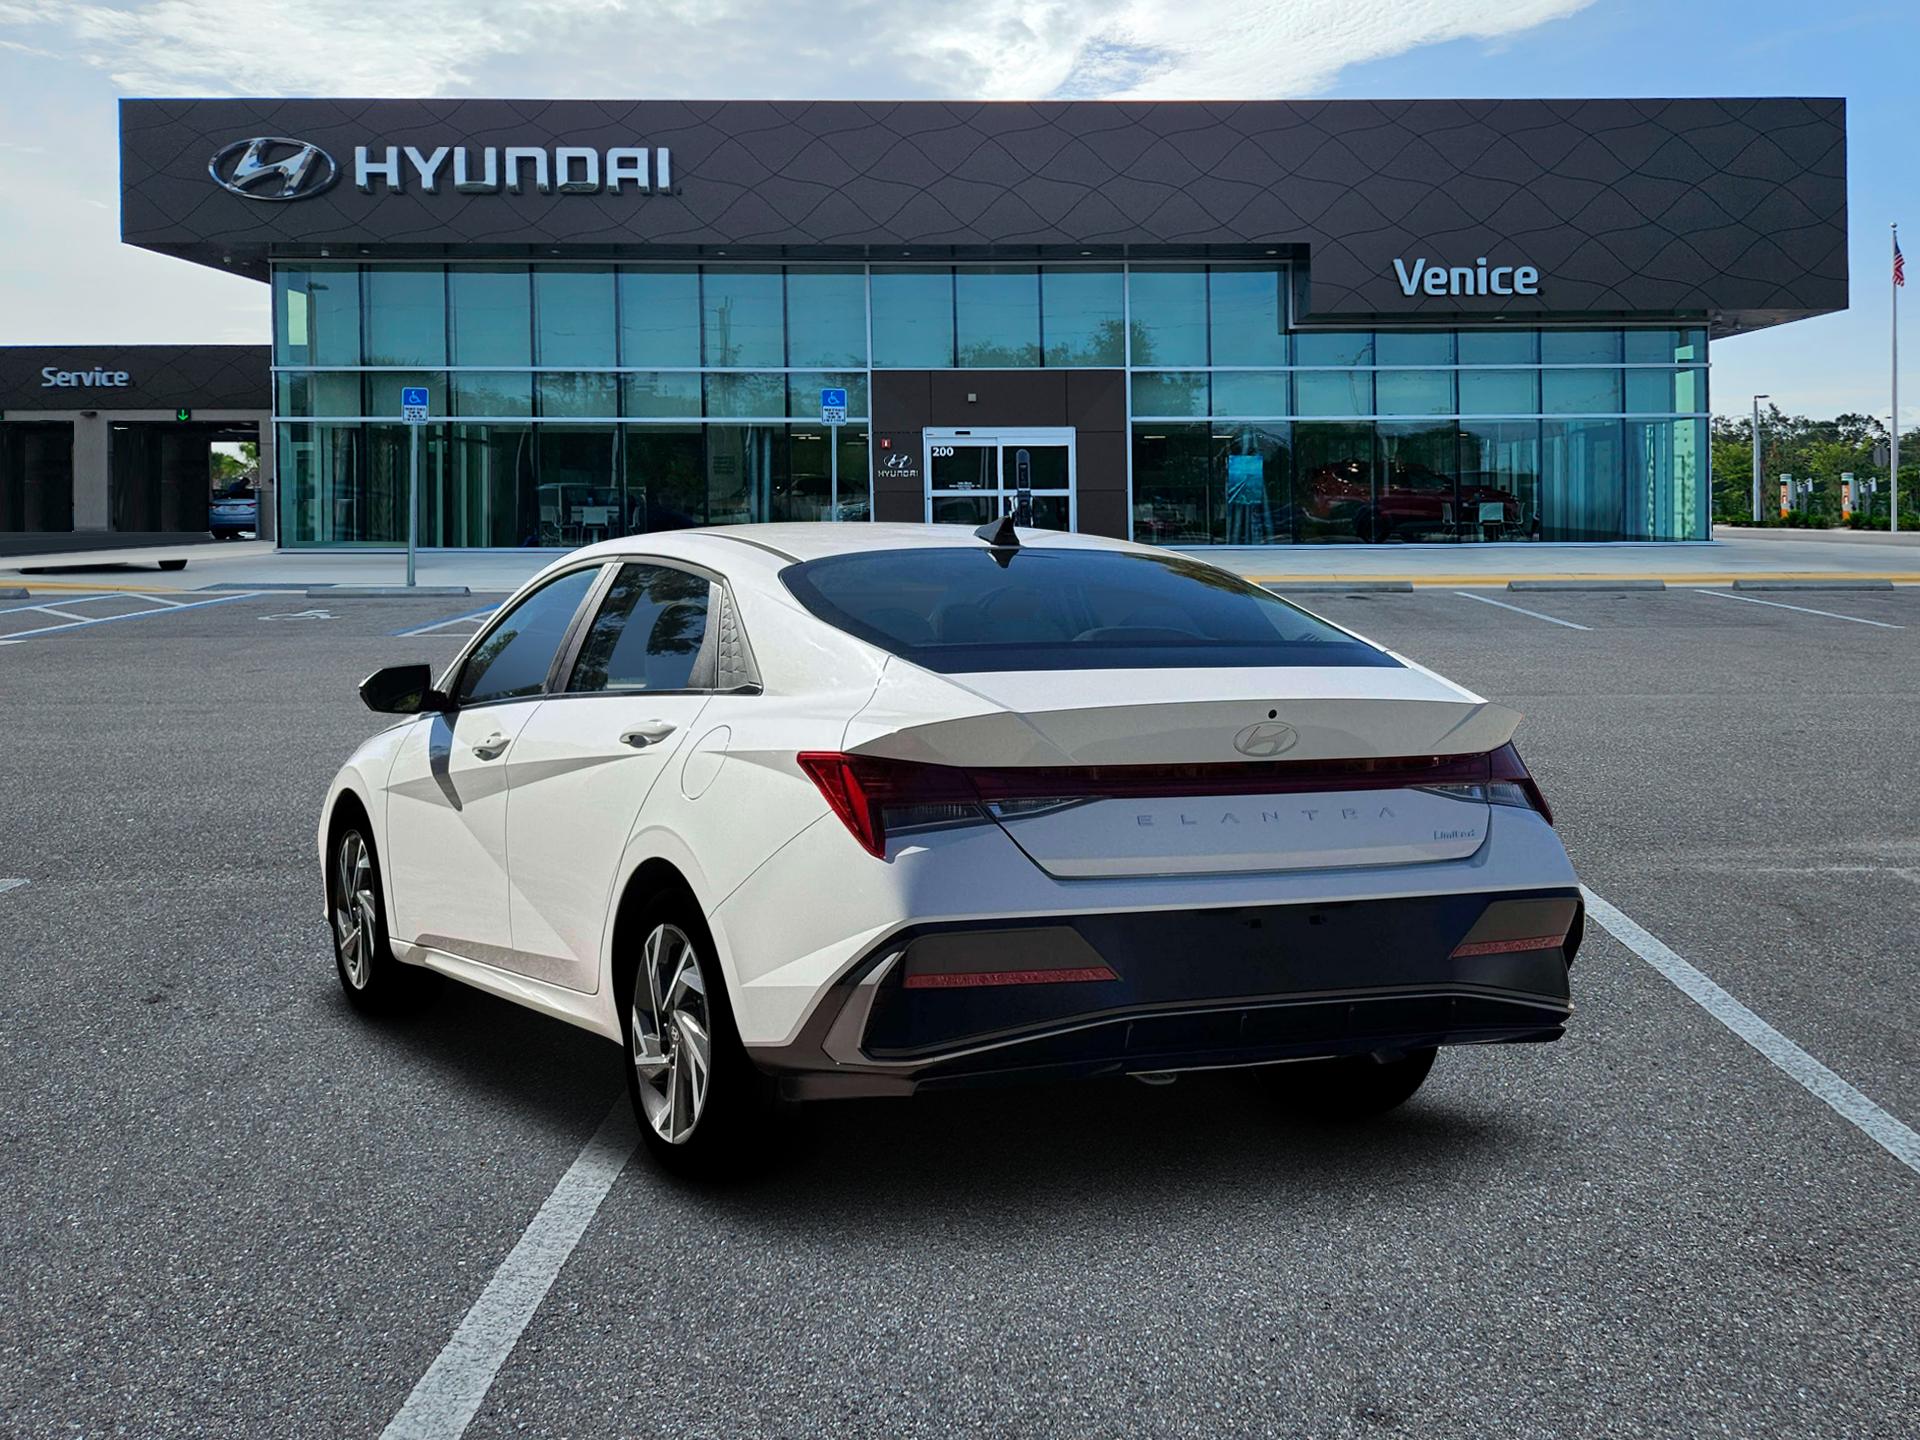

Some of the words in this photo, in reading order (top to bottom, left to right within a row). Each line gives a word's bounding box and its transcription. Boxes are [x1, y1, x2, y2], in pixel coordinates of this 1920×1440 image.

[353, 146, 672, 193] HYUNDAI
[1393, 257, 1539, 296] Venice
[41, 367, 129, 388] Service
[932, 447, 954, 457] 200
[878, 470, 919, 478] HYUNDAI
[1136, 806, 1395, 827] ELANTRA
